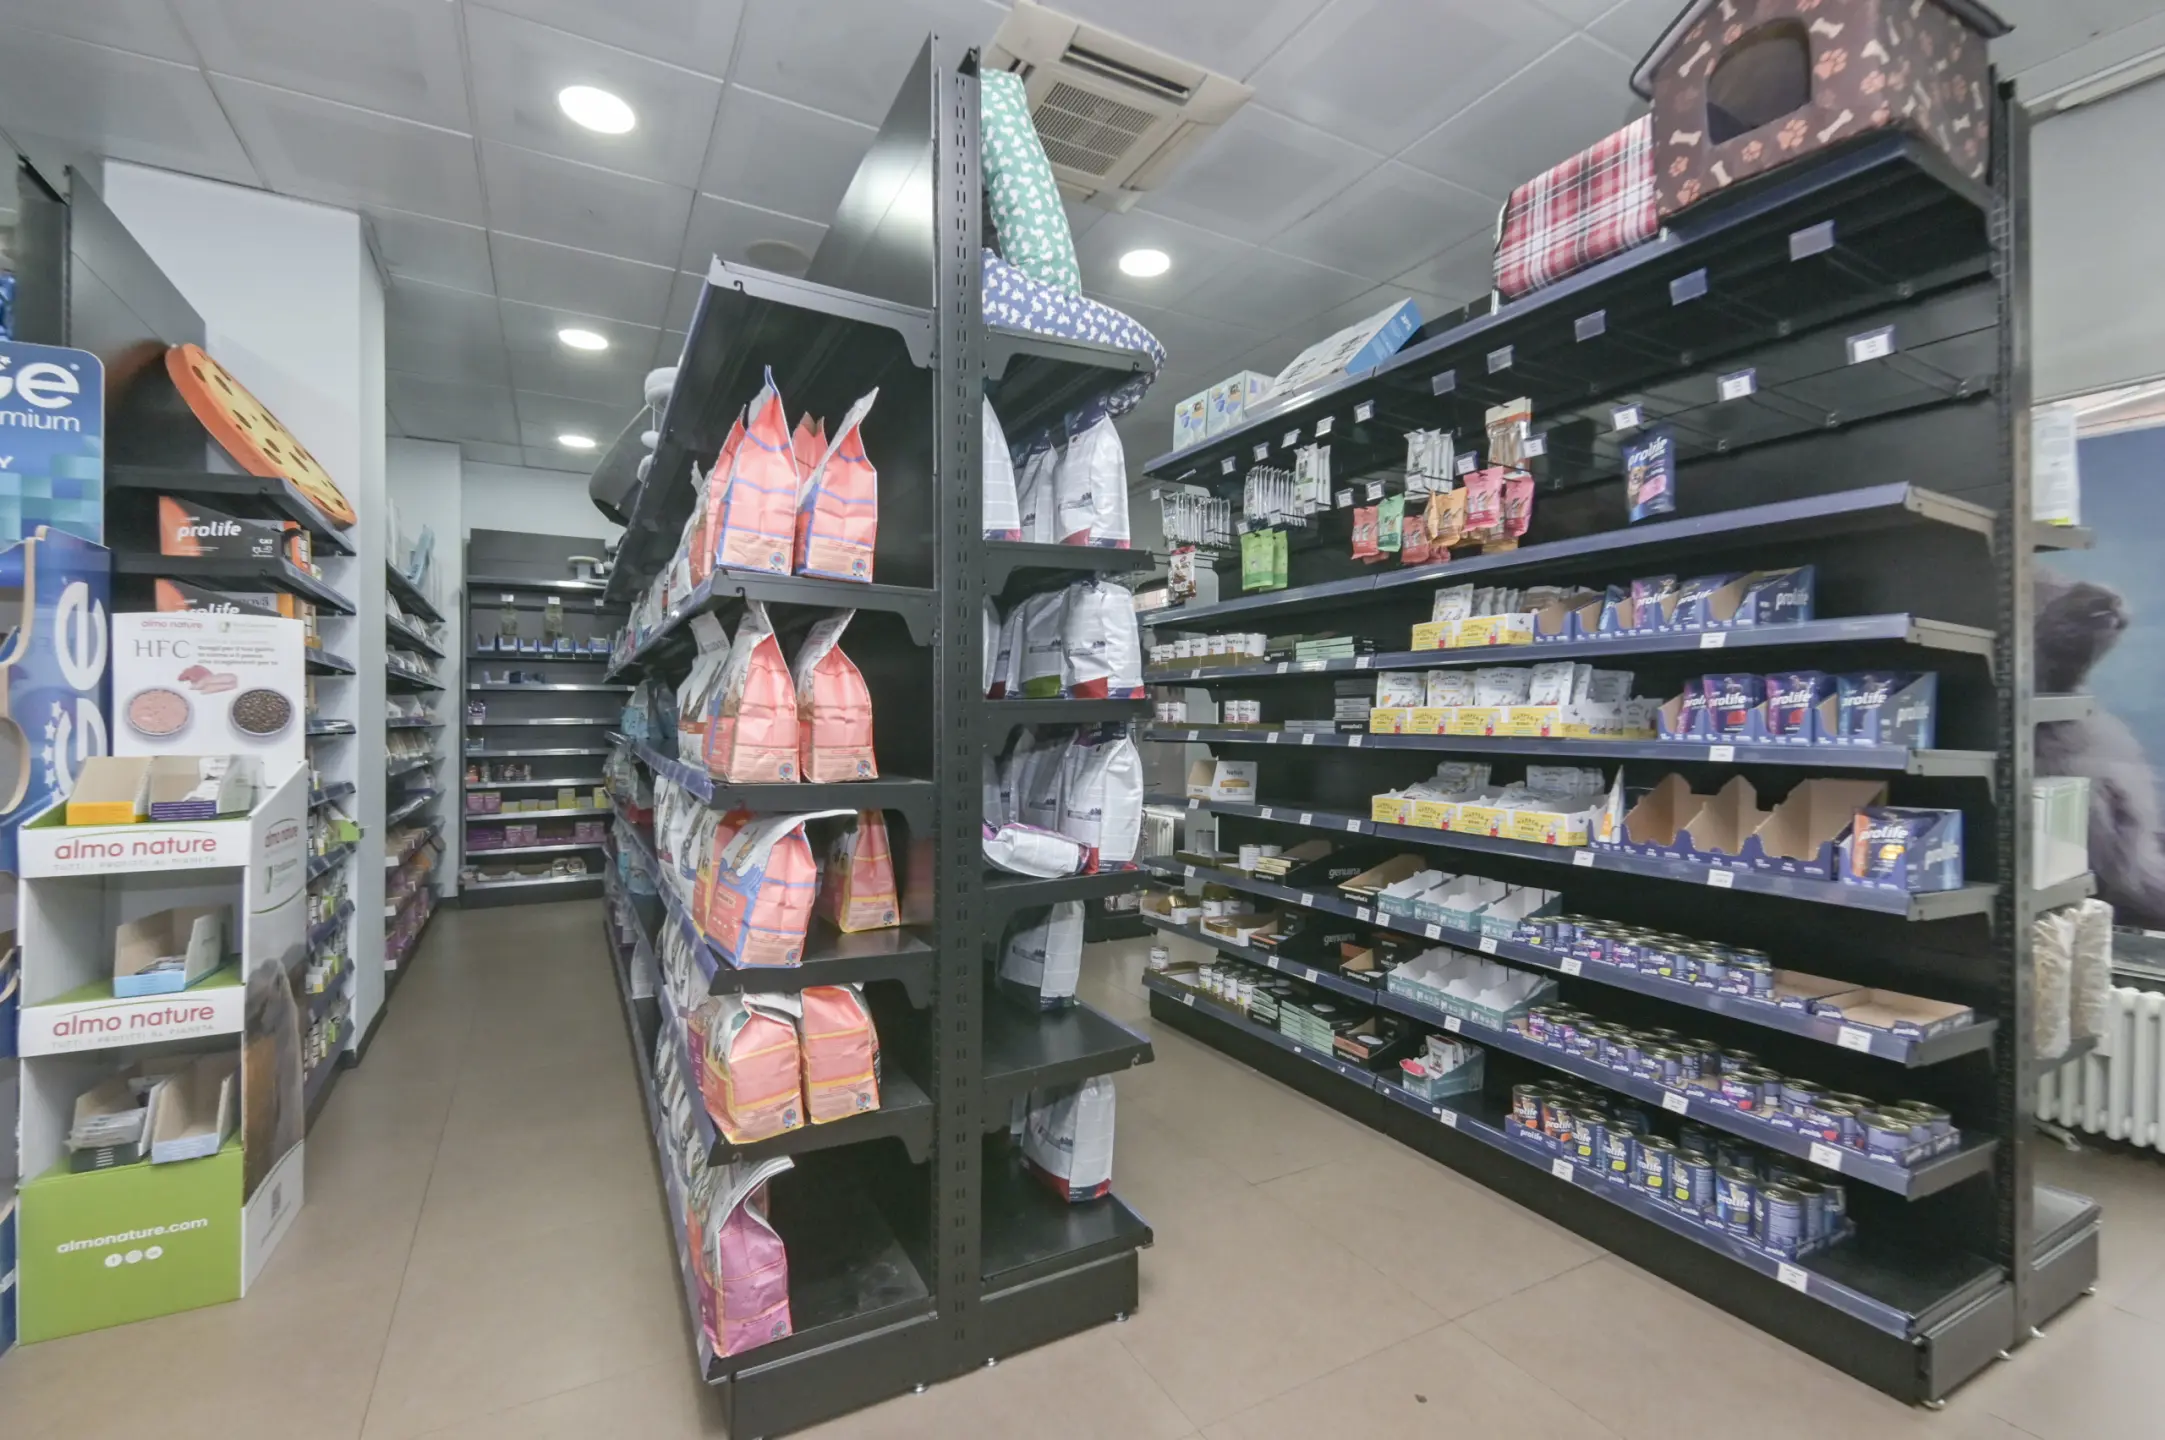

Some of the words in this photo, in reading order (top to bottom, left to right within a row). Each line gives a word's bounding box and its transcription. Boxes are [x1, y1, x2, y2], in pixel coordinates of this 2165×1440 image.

[176, 520, 242, 541] prolife
[141, 620, 167, 628] almo
[170, 620, 203, 629] nature
[132, 639, 191, 658] HFC
[1707, 692, 1746, 709] prolife
[1770, 689, 1812, 707] prolife
[1859, 825, 1909, 842] prolife
[55, 839, 124, 860] almo
[132, 836, 217, 856] nature
[1328, 867, 1361, 880] genuina
[53, 1015, 122, 1036] almo
[130, 1006, 215, 1029] nature
[1520, 1128, 1543, 1142] prolife
[56, 1218, 208, 1253] almonature.com
